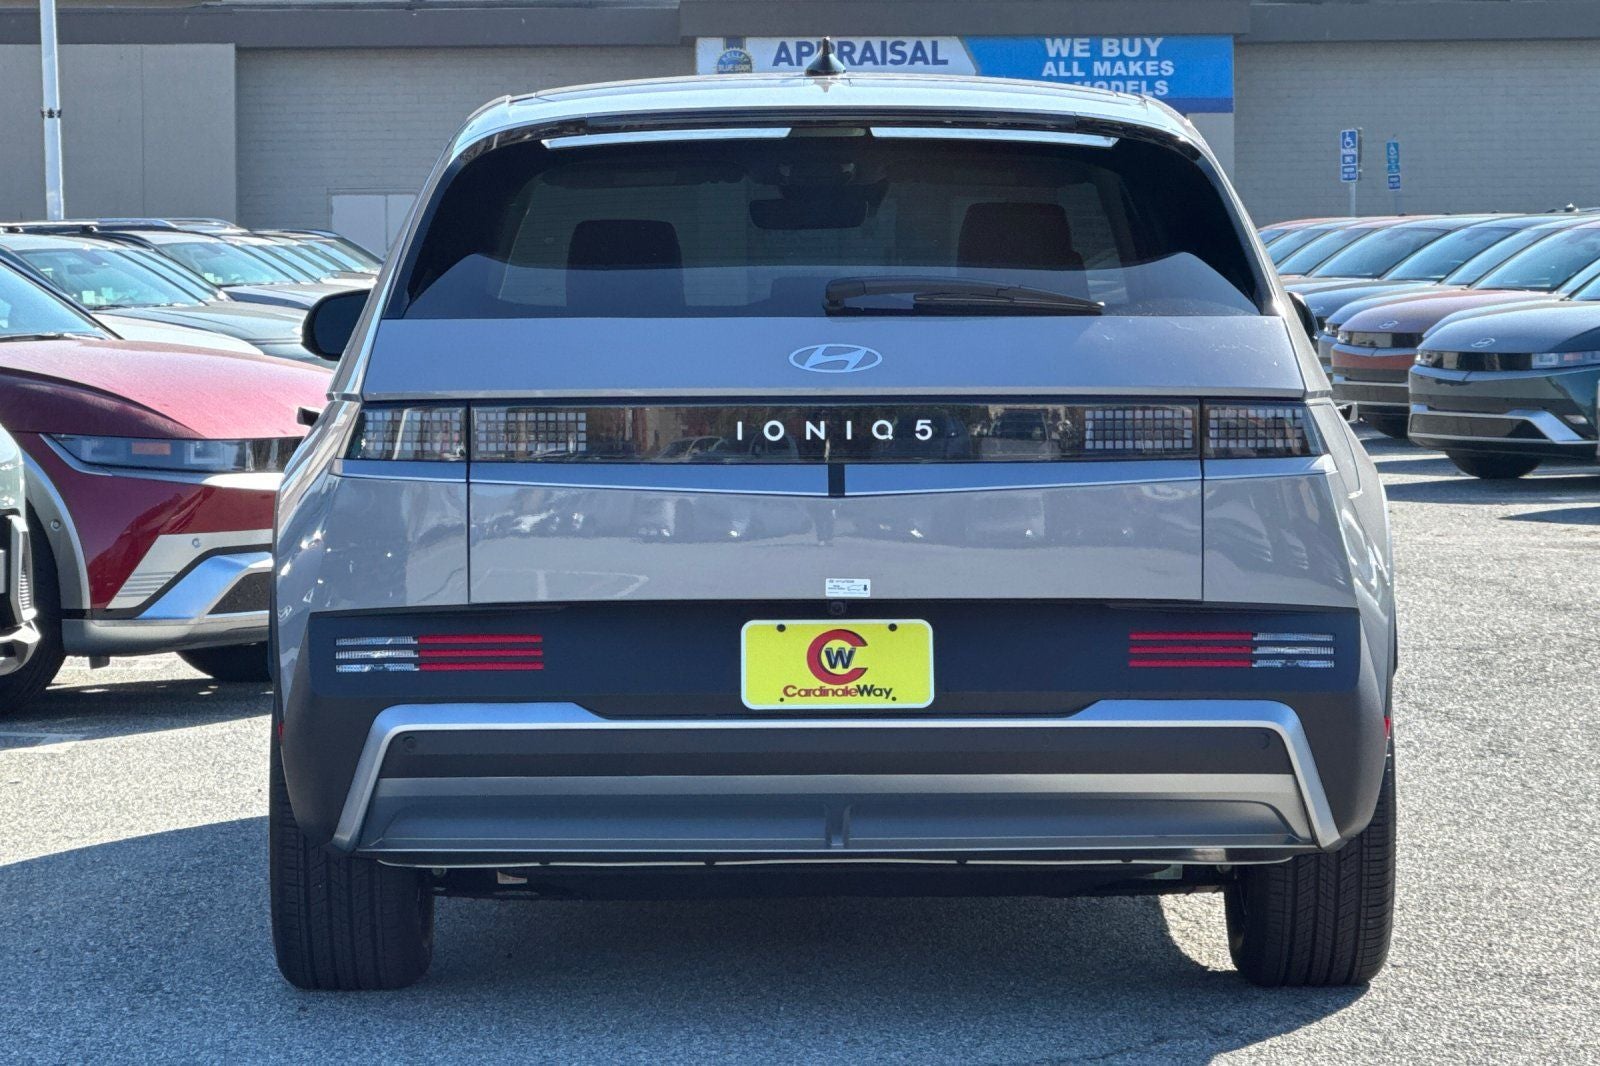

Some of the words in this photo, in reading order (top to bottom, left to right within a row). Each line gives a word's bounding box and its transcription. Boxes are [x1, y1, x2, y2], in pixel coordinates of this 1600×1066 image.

[1044, 38, 1091, 57] WE
[1101, 37, 1164, 57] BUY
[1041, 61, 1086, 77] ALL
[1093, 60, 1175, 77] MAKES
[736, 419, 894, 442] IONIQ
[914, 419, 933, 441] 5
[782, 684, 893, 699] CardinaleWay
